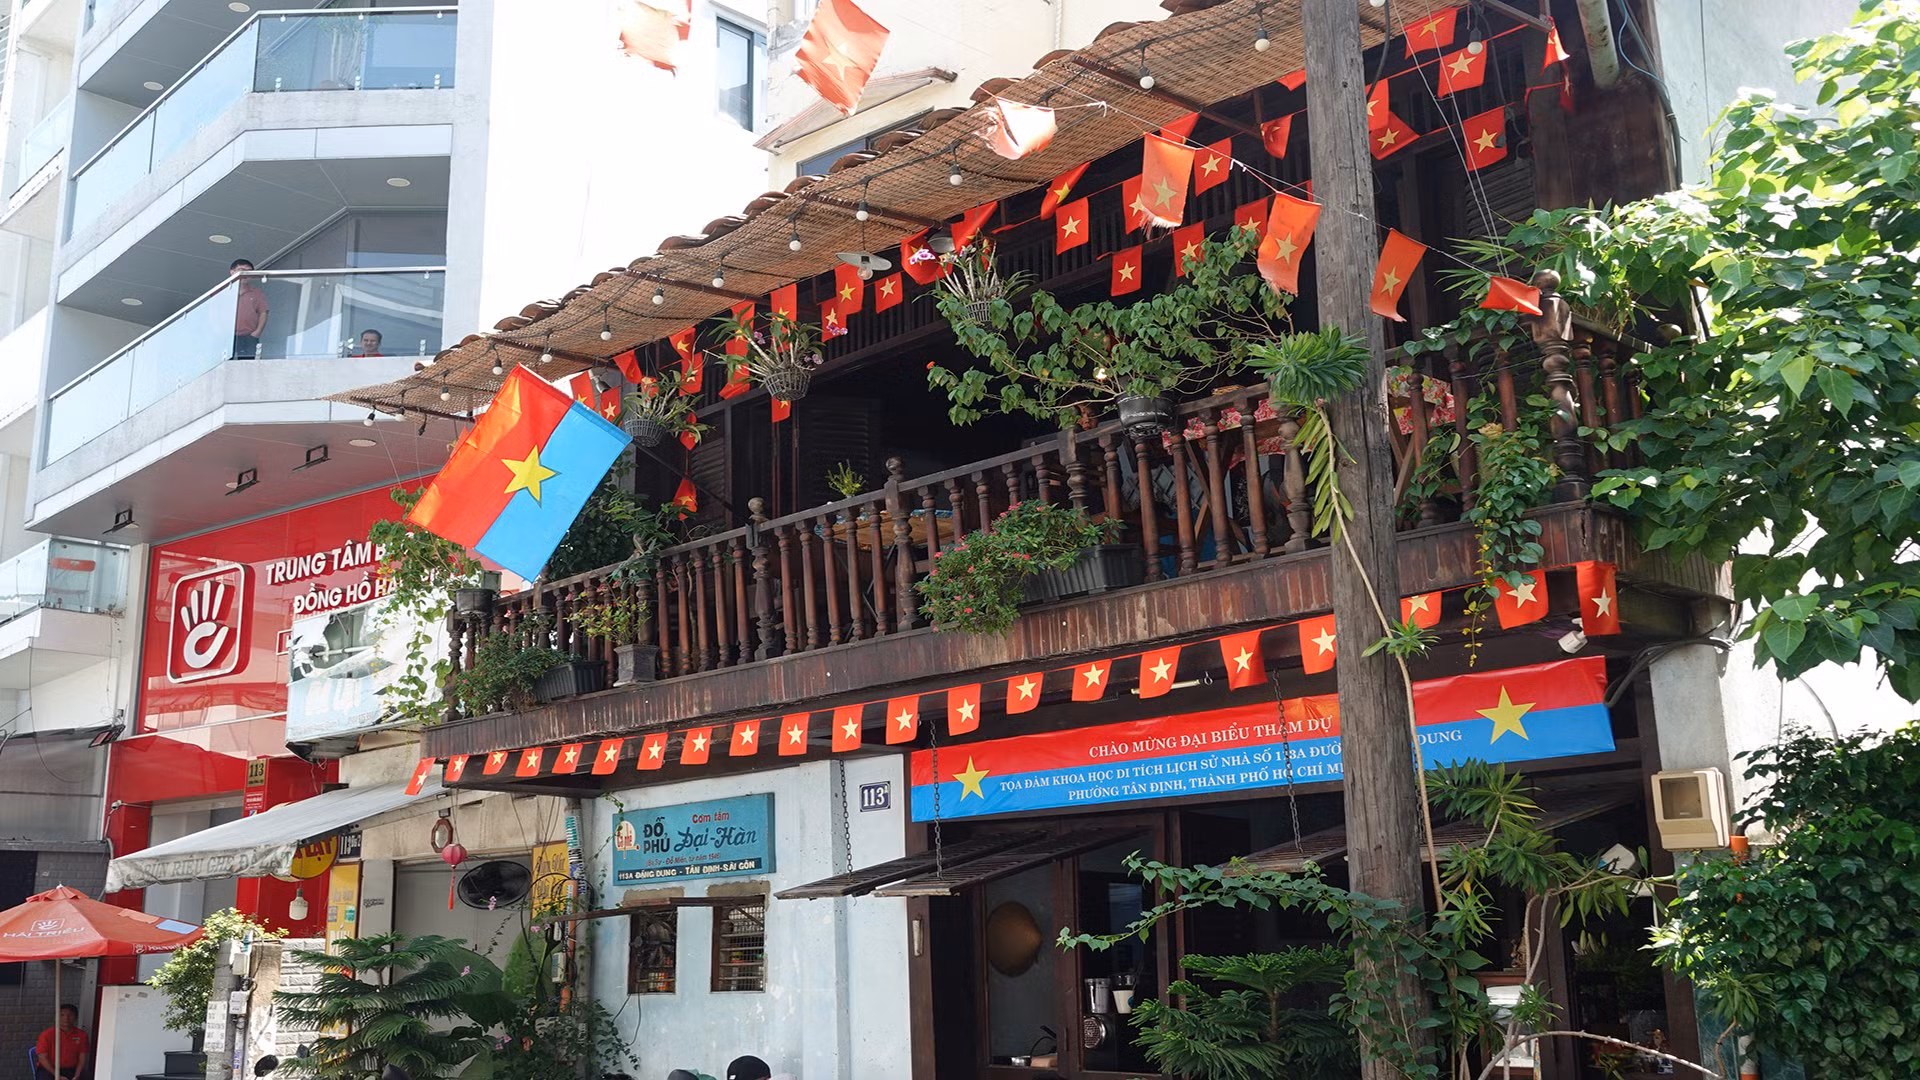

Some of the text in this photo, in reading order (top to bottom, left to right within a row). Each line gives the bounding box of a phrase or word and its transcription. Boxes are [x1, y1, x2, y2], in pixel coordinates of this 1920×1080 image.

[266, 552, 326, 585] TRUNG
[332, 540, 372, 571] TÂM
[293, 582, 343, 614] ĐỒNG
[346, 571, 371, 604] HỒ
[1089, 739, 1129, 758] CHÀO
[1132, 736, 1177, 753] MỪNG
[1181, 732, 1208, 748] ĐẠI
[1211, 722, 1250, 743] BIỂU
[1307, 715, 1333, 733] DỰ
[250, 763, 264, 777] 113
[1000, 780, 1023, 793] TỌA
[1024, 775, 1049, 789] ĐÀM
[1052, 772, 1085, 786] KHOA
[1088, 769, 1114, 783] HỌC
[1116, 767, 1130, 778] DI
[1132, 763, 1163, 777] TÍCH
[1167, 760, 1198, 775] LỊCH
[1201, 754, 1219, 770] SỬ
[1221, 752, 1251, 767] NHÀ
[1253, 748, 1272, 763] SỐ
[1309, 741, 1342, 757] ĐƯỜ
[1068, 784, 1119, 801] PHƯỜNG
[1121, 781, 1147, 795] TÂN
[1149, 779, 1187, 795] ĐỊNH,
[1189, 773, 1236, 788] THÀNH
[1240, 766, 1269, 783] PHỐ
[1297, 763, 1323, 777] CHÍ
[643, 817, 665, 838] ĐỖ
[692, 813, 711, 825] Cơm
[643, 831, 671, 854] PHỦ
[618, 872, 634, 880] 113A
[656, 868, 677, 878] DUNG
[685, 865, 700, 875] TÂN
